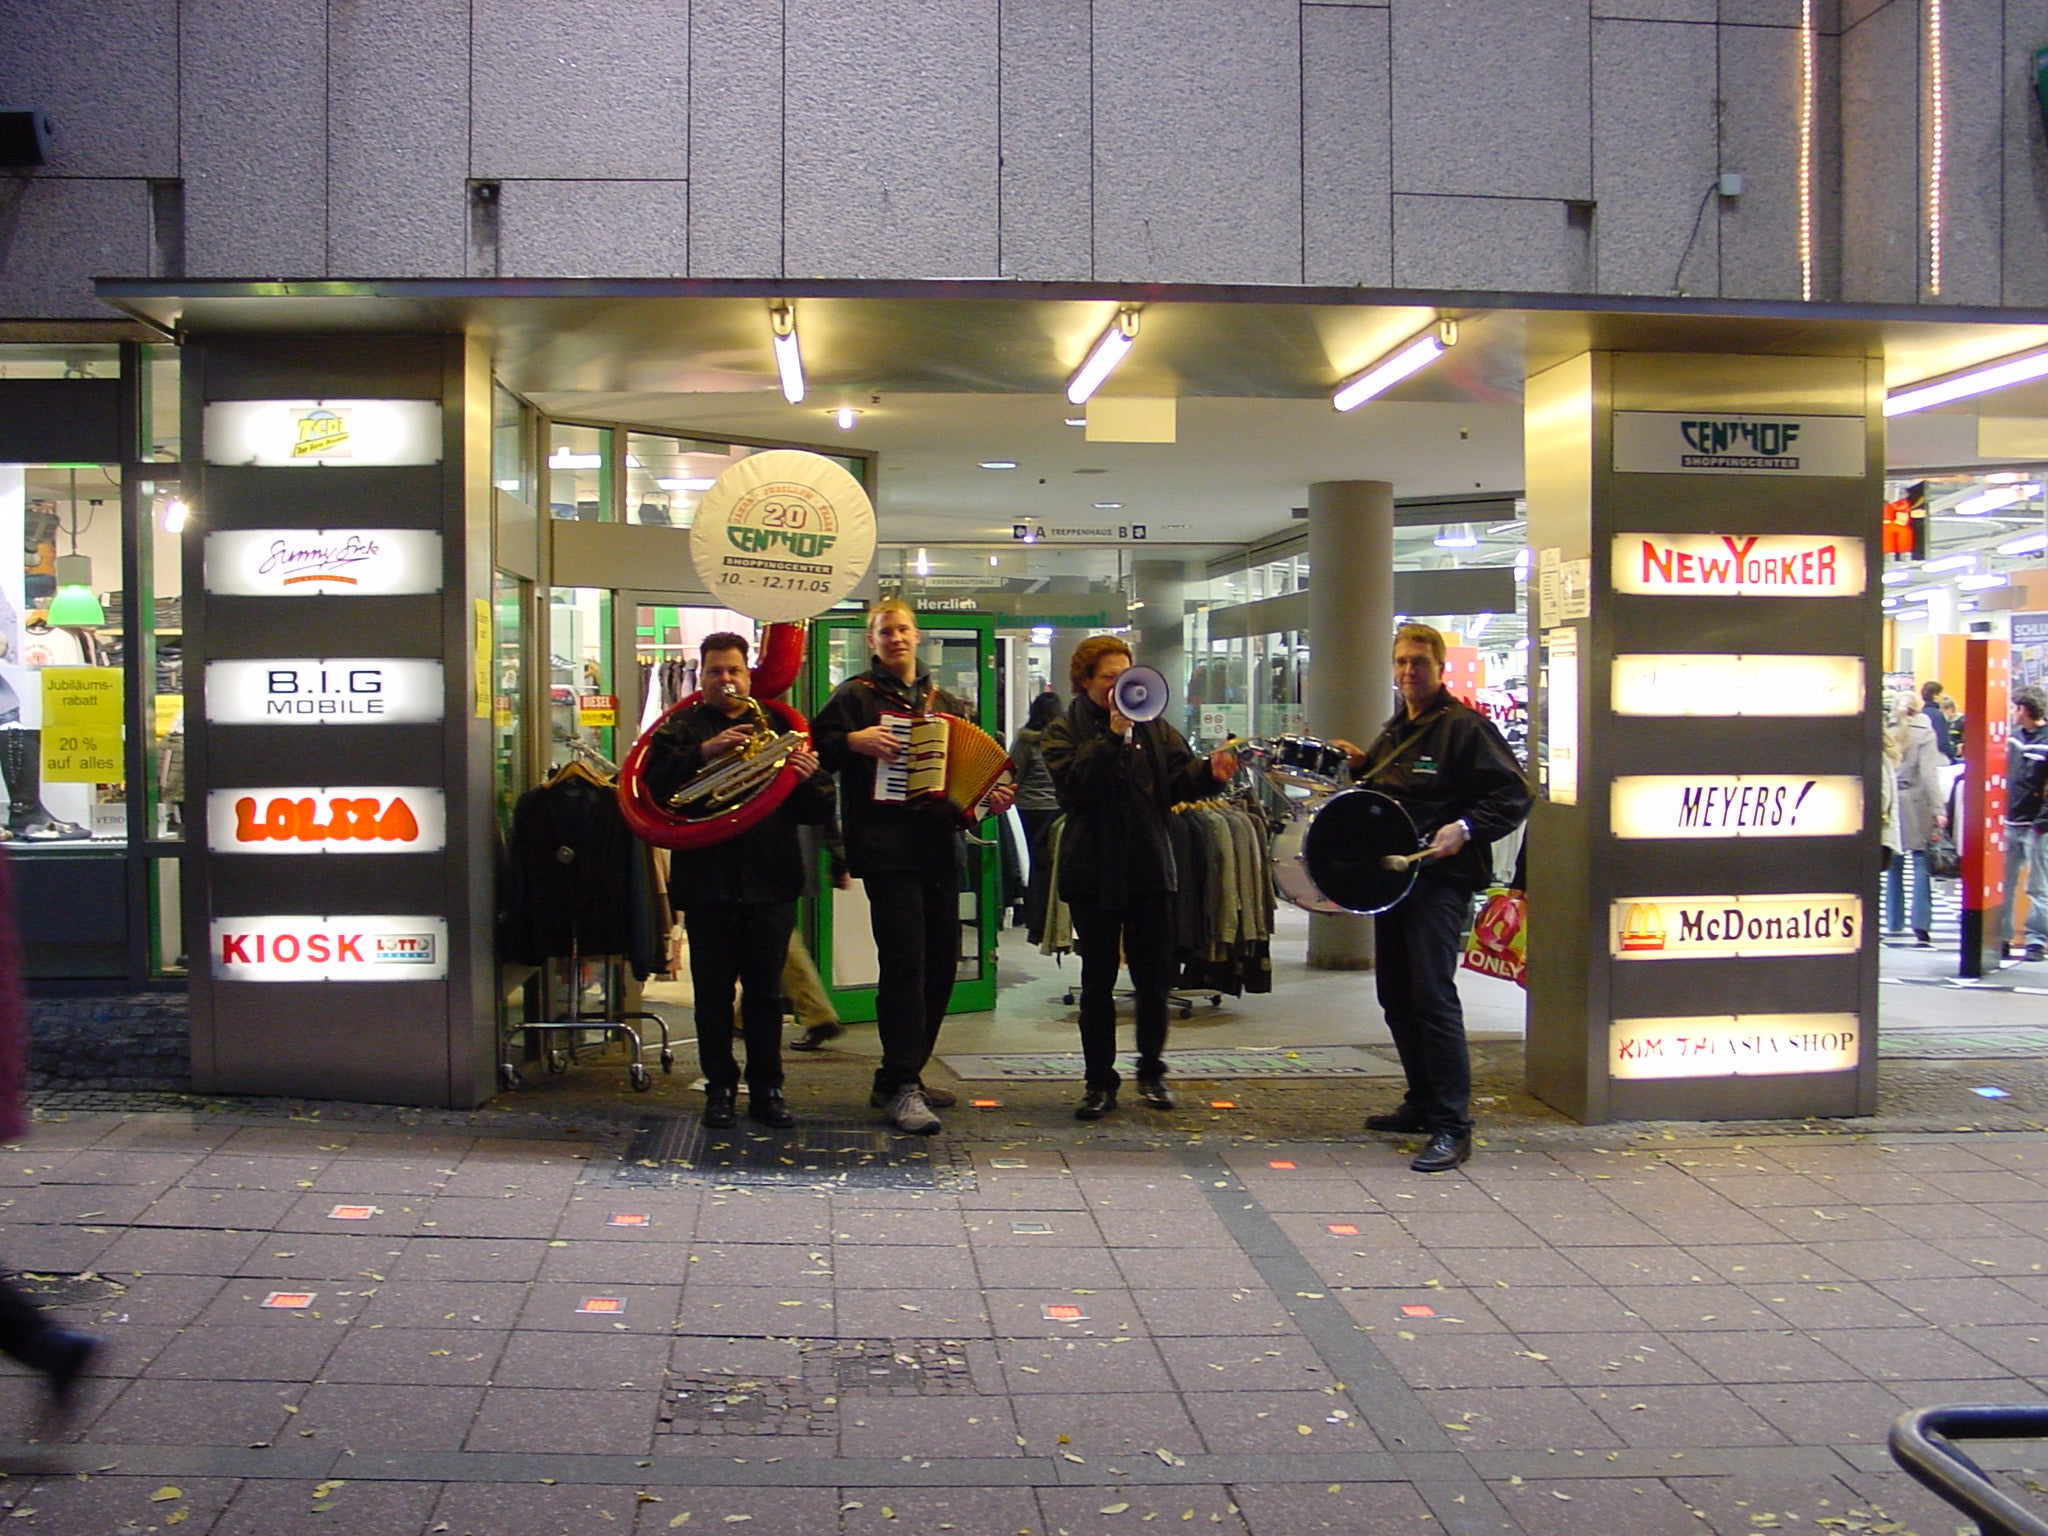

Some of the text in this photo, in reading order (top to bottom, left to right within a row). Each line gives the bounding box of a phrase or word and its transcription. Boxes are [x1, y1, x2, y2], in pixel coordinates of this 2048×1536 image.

[1681, 421, 1800, 455] CENTHOF
[1683, 456, 1798, 469] SHOPPINGCENTER
[762, 502, 807, 529] 20
[726, 525, 838, 558] CENTHOF
[1035, 526, 1128, 538] A TREPPENHAUS B
[726, 558, 831, 574] SHOPPINGCENTER
[721, 572, 743, 585] 10.
[762, 576, 831, 593] 12.11.05
[917, 598, 977, 610] Herzlich
[47, 679, 114, 691] Jubiläums-
[268, 670, 382, 694] B.I.G
[62, 695, 98, 706] rabatt
[267, 700, 385, 714] MOBILE
[59, 737, 97, 751] 20 %
[47, 756, 114, 769] auf alles
[1678, 781, 1816, 827] MEYERS!
[235, 796, 419, 842] LOLITA
[1679, 907, 1855, 942] McDonald's
[222, 934, 430, 964] KIOSK LOTTO
[1468, 949, 1525, 979] ONLY
[1618, 1037, 1664, 1060] KIM
[1788, 1032, 1854, 1052] SHOP
